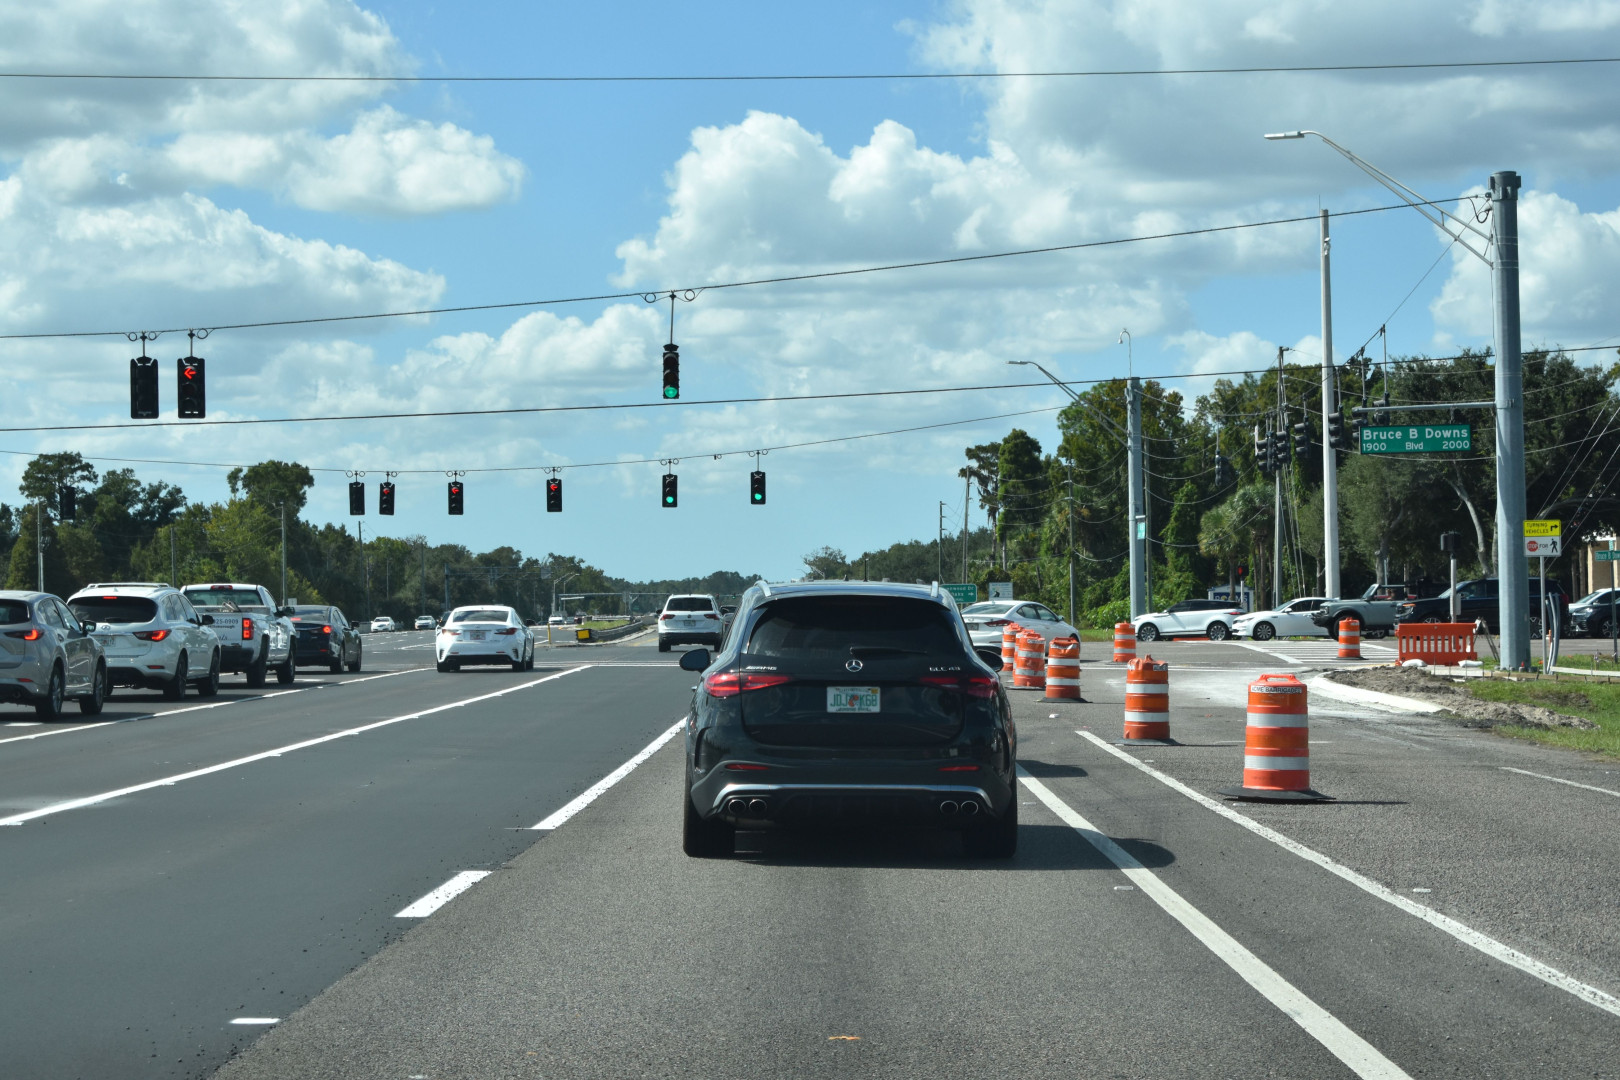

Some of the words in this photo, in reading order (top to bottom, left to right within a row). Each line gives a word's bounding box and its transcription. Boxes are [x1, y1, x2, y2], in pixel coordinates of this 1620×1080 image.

[1363, 430, 1402, 440] Bruce
[1409, 428, 1418, 439] B
[1425, 428, 1468, 439] Downs
[1362, 443, 1387, 451] 1900
[1405, 442, 1424, 450] Blvd
[1442, 440, 1470, 450] 2000
